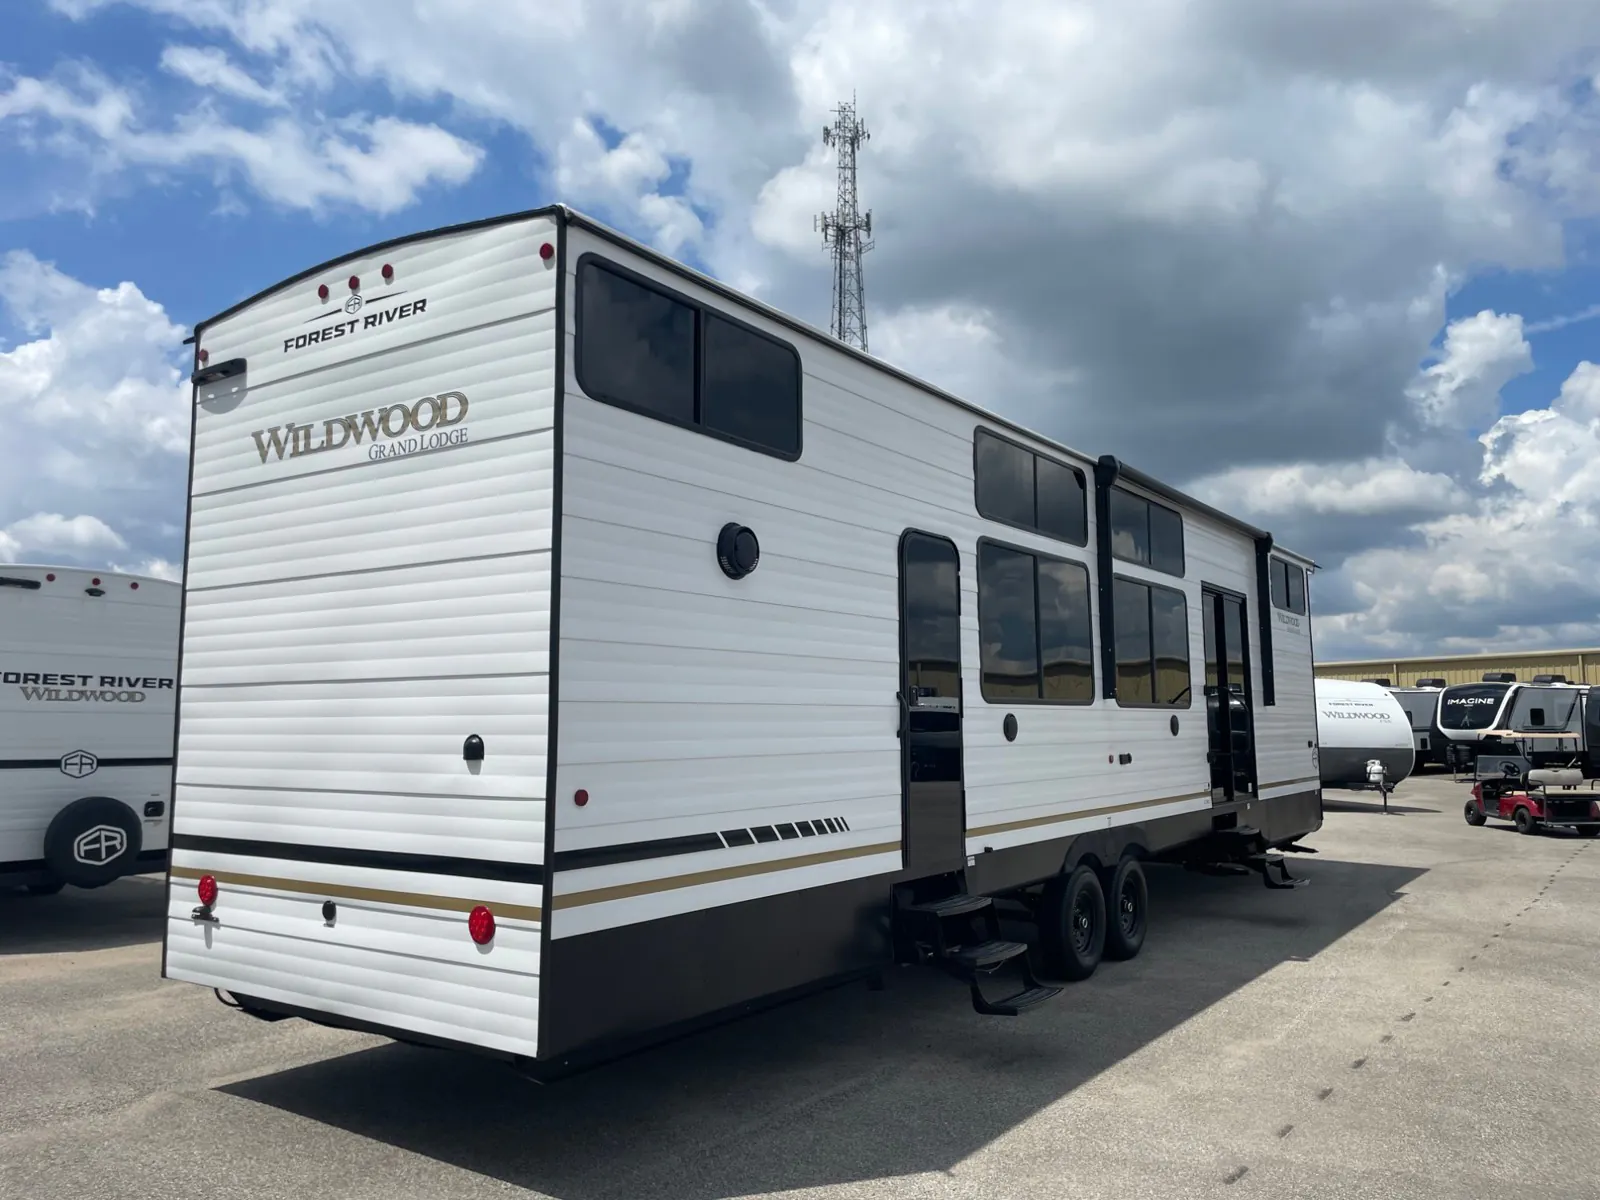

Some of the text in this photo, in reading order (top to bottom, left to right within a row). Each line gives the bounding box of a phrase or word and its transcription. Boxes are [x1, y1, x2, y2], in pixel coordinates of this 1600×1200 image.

[284, 299, 427, 353] FOREST RIVER
[251, 391, 469, 464] WILDWOOD
[369, 427, 468, 461] GRAND LODGE
[100, 676, 173, 689] RIVER
[20, 686, 146, 702] WILDWOOD
[1447, 697, 1495, 705] IMAGINE
[1322, 711, 1391, 720] WILDWOOD
